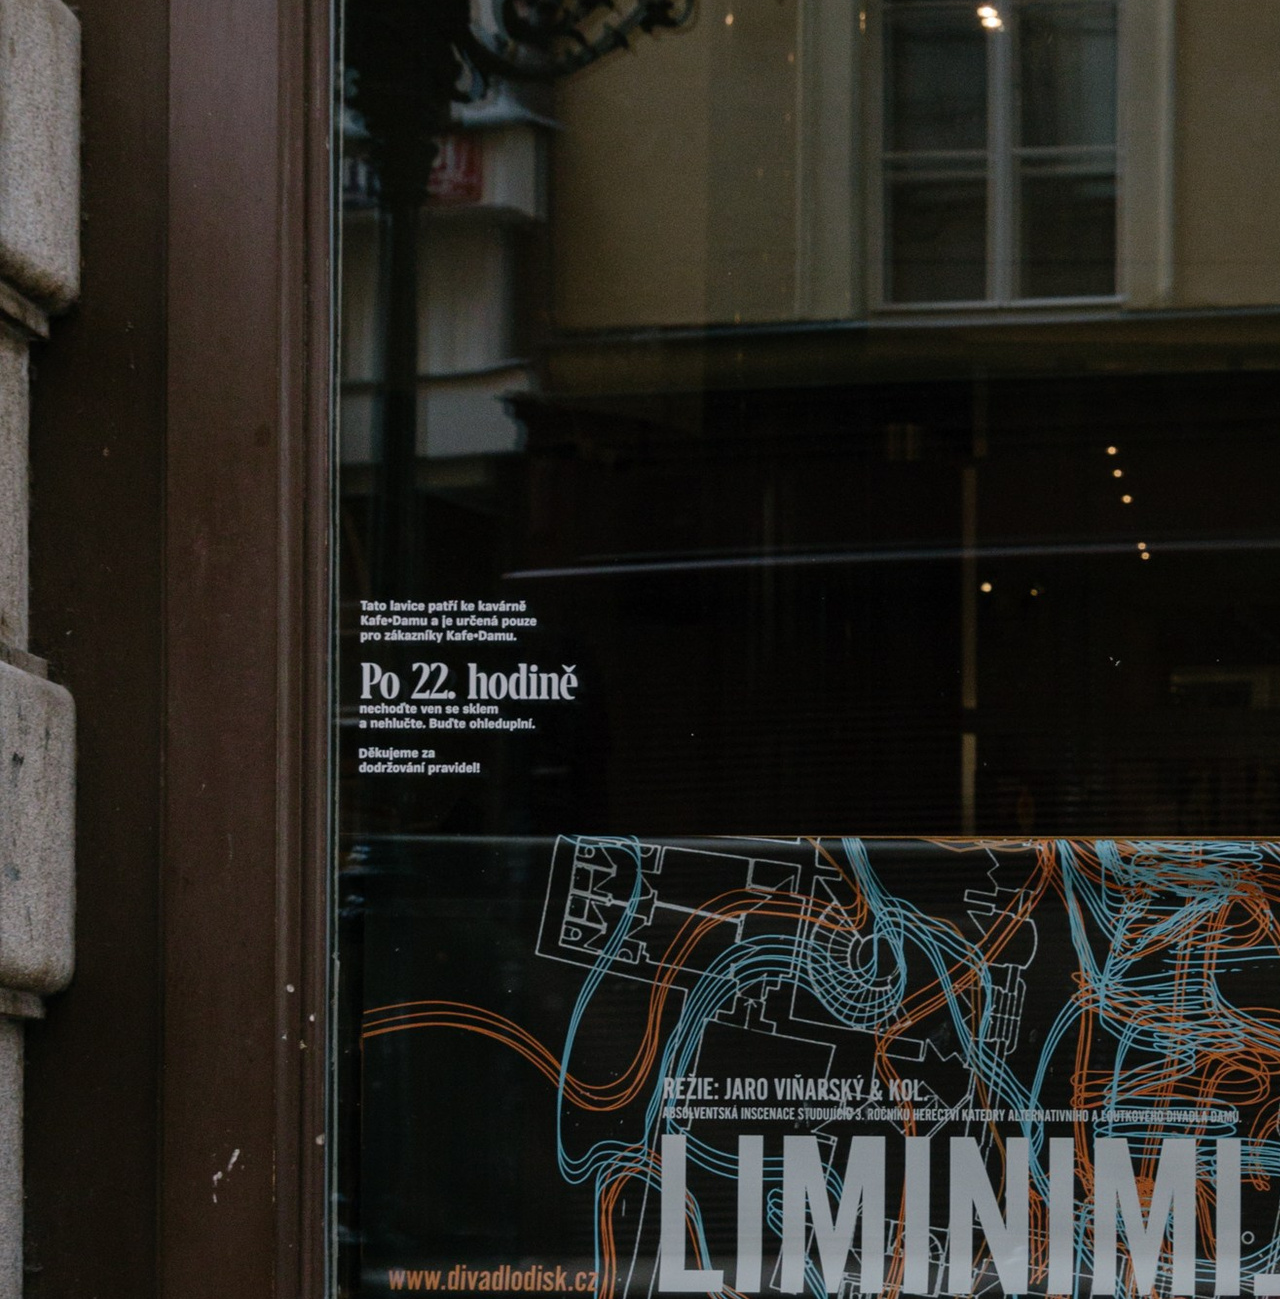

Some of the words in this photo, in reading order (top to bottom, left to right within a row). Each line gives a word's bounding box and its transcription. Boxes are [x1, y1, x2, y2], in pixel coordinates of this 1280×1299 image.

[360, 601, 386, 611] Tato
[390, 601, 424, 611] lavice
[428, 600, 458, 613] patří
[461, 601, 475, 611] ke
[478, 601, 526, 612] kavárně
[431, 618, 438, 626] a
[442, 616, 452, 628] je
[456, 615, 498, 626] určená
[502, 617, 537, 628] pouze
[360, 632, 381, 643] pro
[384, 630, 443, 643] zákazníky
[361, 662, 400, 699] Po
[411, 662, 456, 699] 22.
[468, 663, 578, 700] hodině
[360, 703, 417, 714] nechoďte
[421, 706, 442, 714] ven
[446, 706, 459, 714] se
[463, 703, 498, 714] sklem
[359, 720, 367, 729] a
[370, 718, 426, 729] nehlučte.
[429, 718, 466, 729] Buďte
[470, 718, 535, 731] ohleduplní.
[359, 748, 418, 760] Děkujeme
[422, 750, 435, 758] za
[359, 762, 424, 773] dodržování
[428, 762, 480, 775] pravidel!
[663, 1074, 719, 1100] REŽIE:
[724, 1077, 768, 1100] JARO
[774, 1074, 864, 1101] VIŇARSKÝ
[871, 1080, 883, 1101] &
[889, 1079, 928, 1101] KOL.
[662, 1105, 738, 1120] ABSOLVENTSKÁ
[741, 1107, 795, 1120] INSCENACE
[856, 1108, 865, 1121] 3.
[962, 1109, 1005, 1121] KATEDRY
[1007, 1107, 1088, 1122] ALTERNATIVNÍHO
[1092, 1111, 1098, 1122] A
[1166, 1111, 1208, 1123] DIVADLA
[389, 1265, 598, 1292] www.divadlodisk.cz
